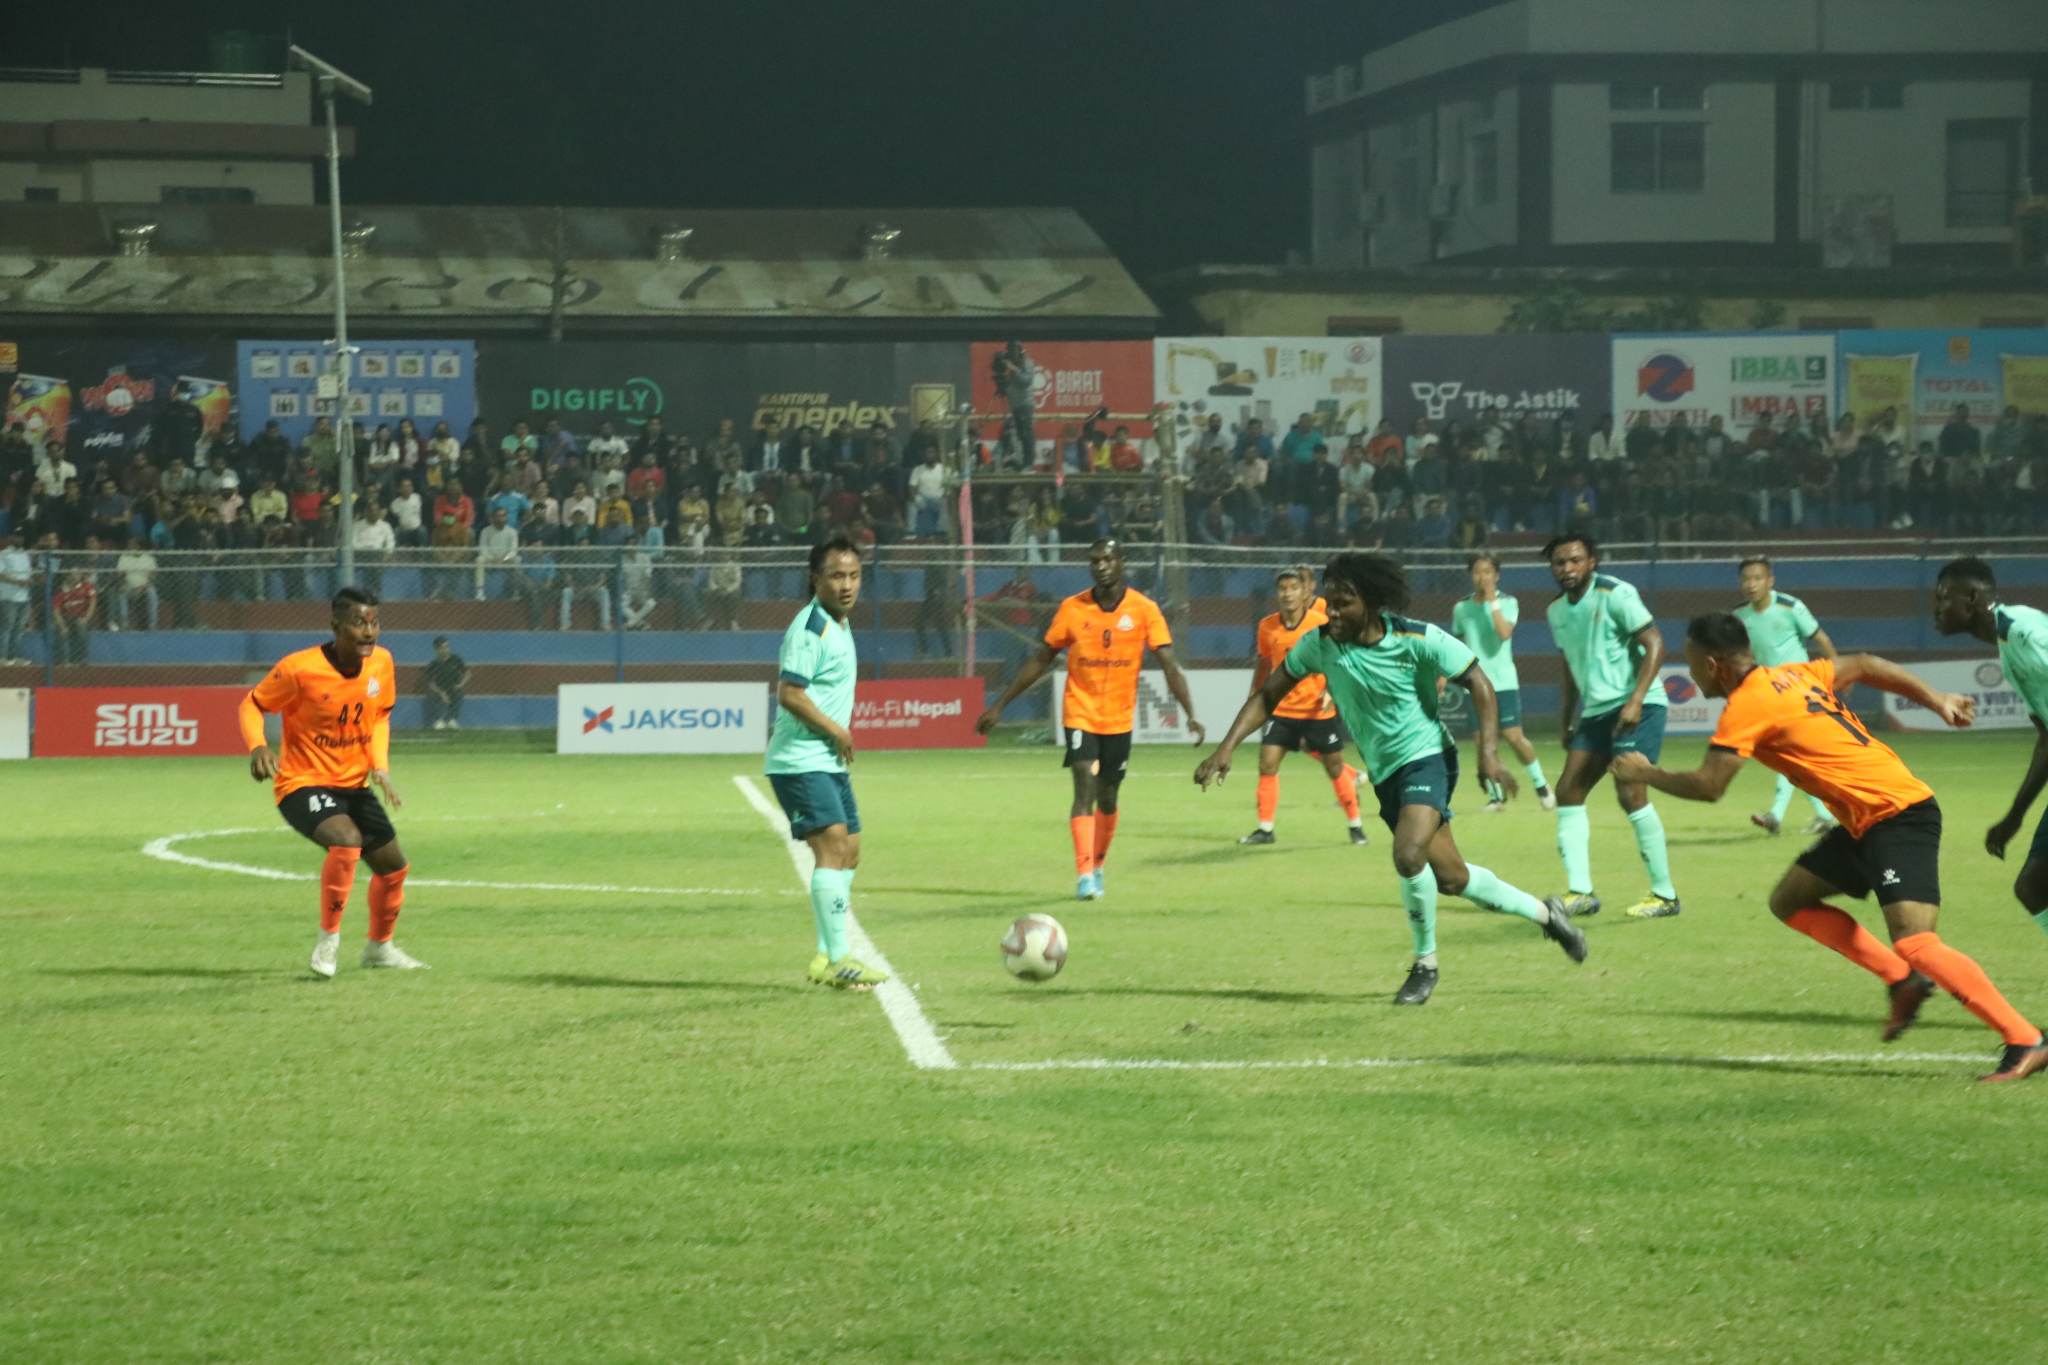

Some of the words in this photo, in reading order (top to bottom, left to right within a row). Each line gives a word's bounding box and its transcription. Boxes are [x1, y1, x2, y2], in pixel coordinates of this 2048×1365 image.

[1742, 356, 1800, 380] BBA
[1056, 369, 1104, 393] BIRAT
[531, 388, 650, 412] DIGIFLY
[1463, 390, 1510, 409] The
[1514, 388, 1581, 409] Astik
[1742, 396, 1799, 417] MBA
[95, 703, 198, 728] SML
[338, 703, 364, 727] 42
[620, 708, 744, 730] JAKSON
[903, 699, 962, 719] Nepal
[95, 728, 198, 747] ISUZU
[308, 794, 337, 812] 42
